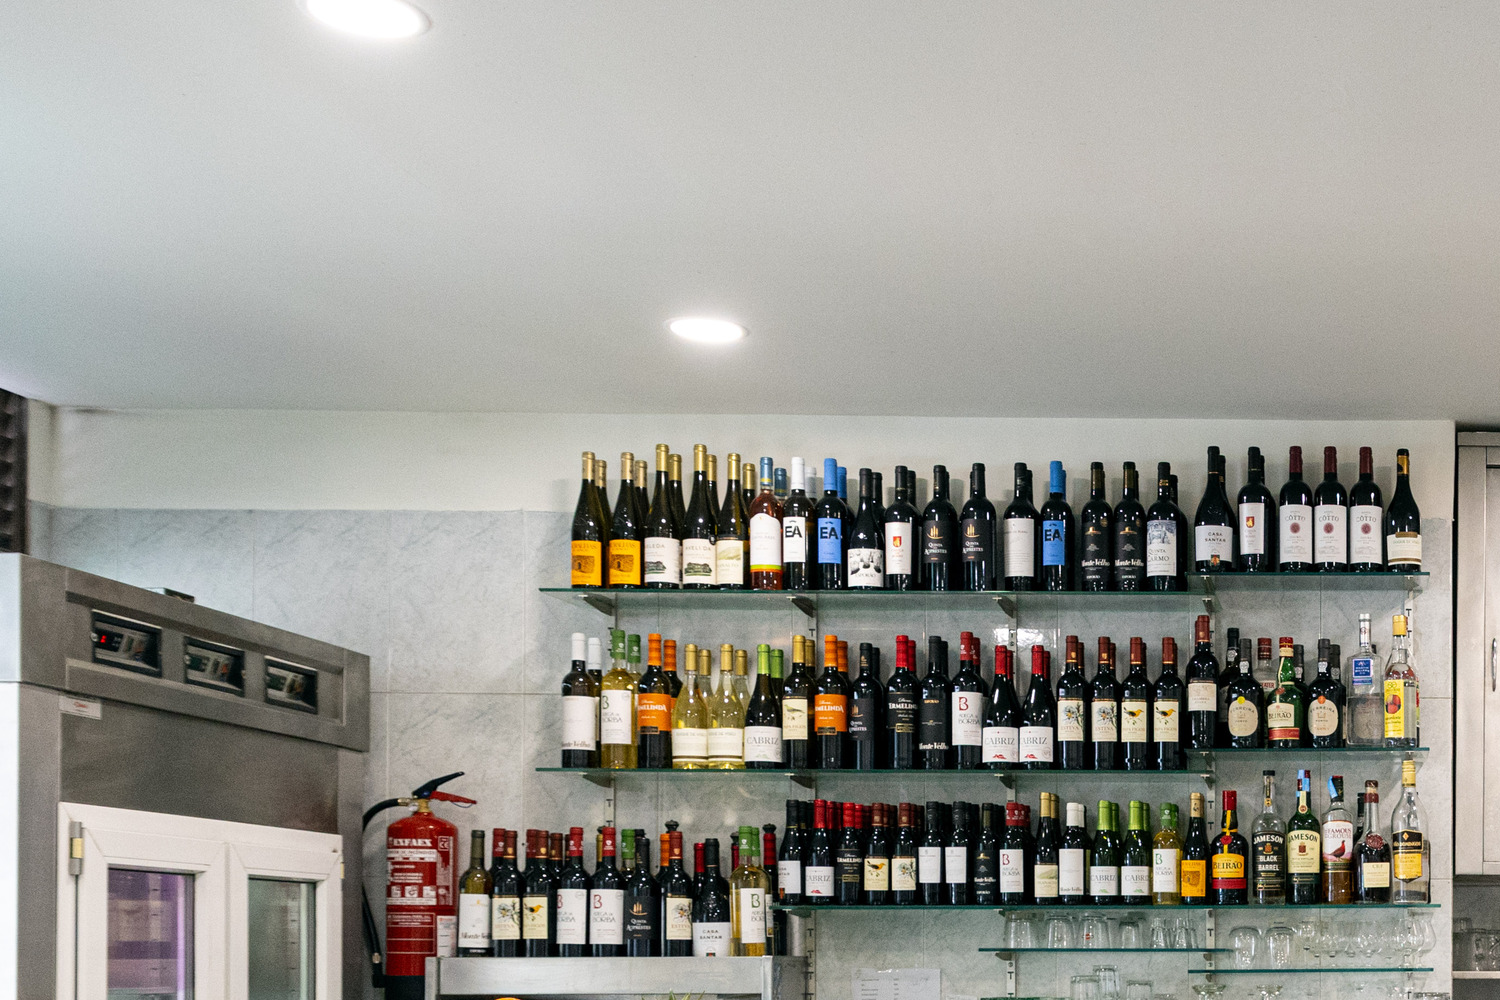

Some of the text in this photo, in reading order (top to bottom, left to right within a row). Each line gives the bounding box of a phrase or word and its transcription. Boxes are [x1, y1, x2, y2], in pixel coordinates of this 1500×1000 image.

[785, 525, 802, 538] EA
[820, 526, 839, 540] EA
[1044, 529, 1063, 542] EA
[746, 736, 780, 746] CABRIZ
[1252, 834, 1284, 845] JAMESON
[1287, 833, 1318, 844] JAMESON
[1212, 860, 1244, 870] BEIRÃO
